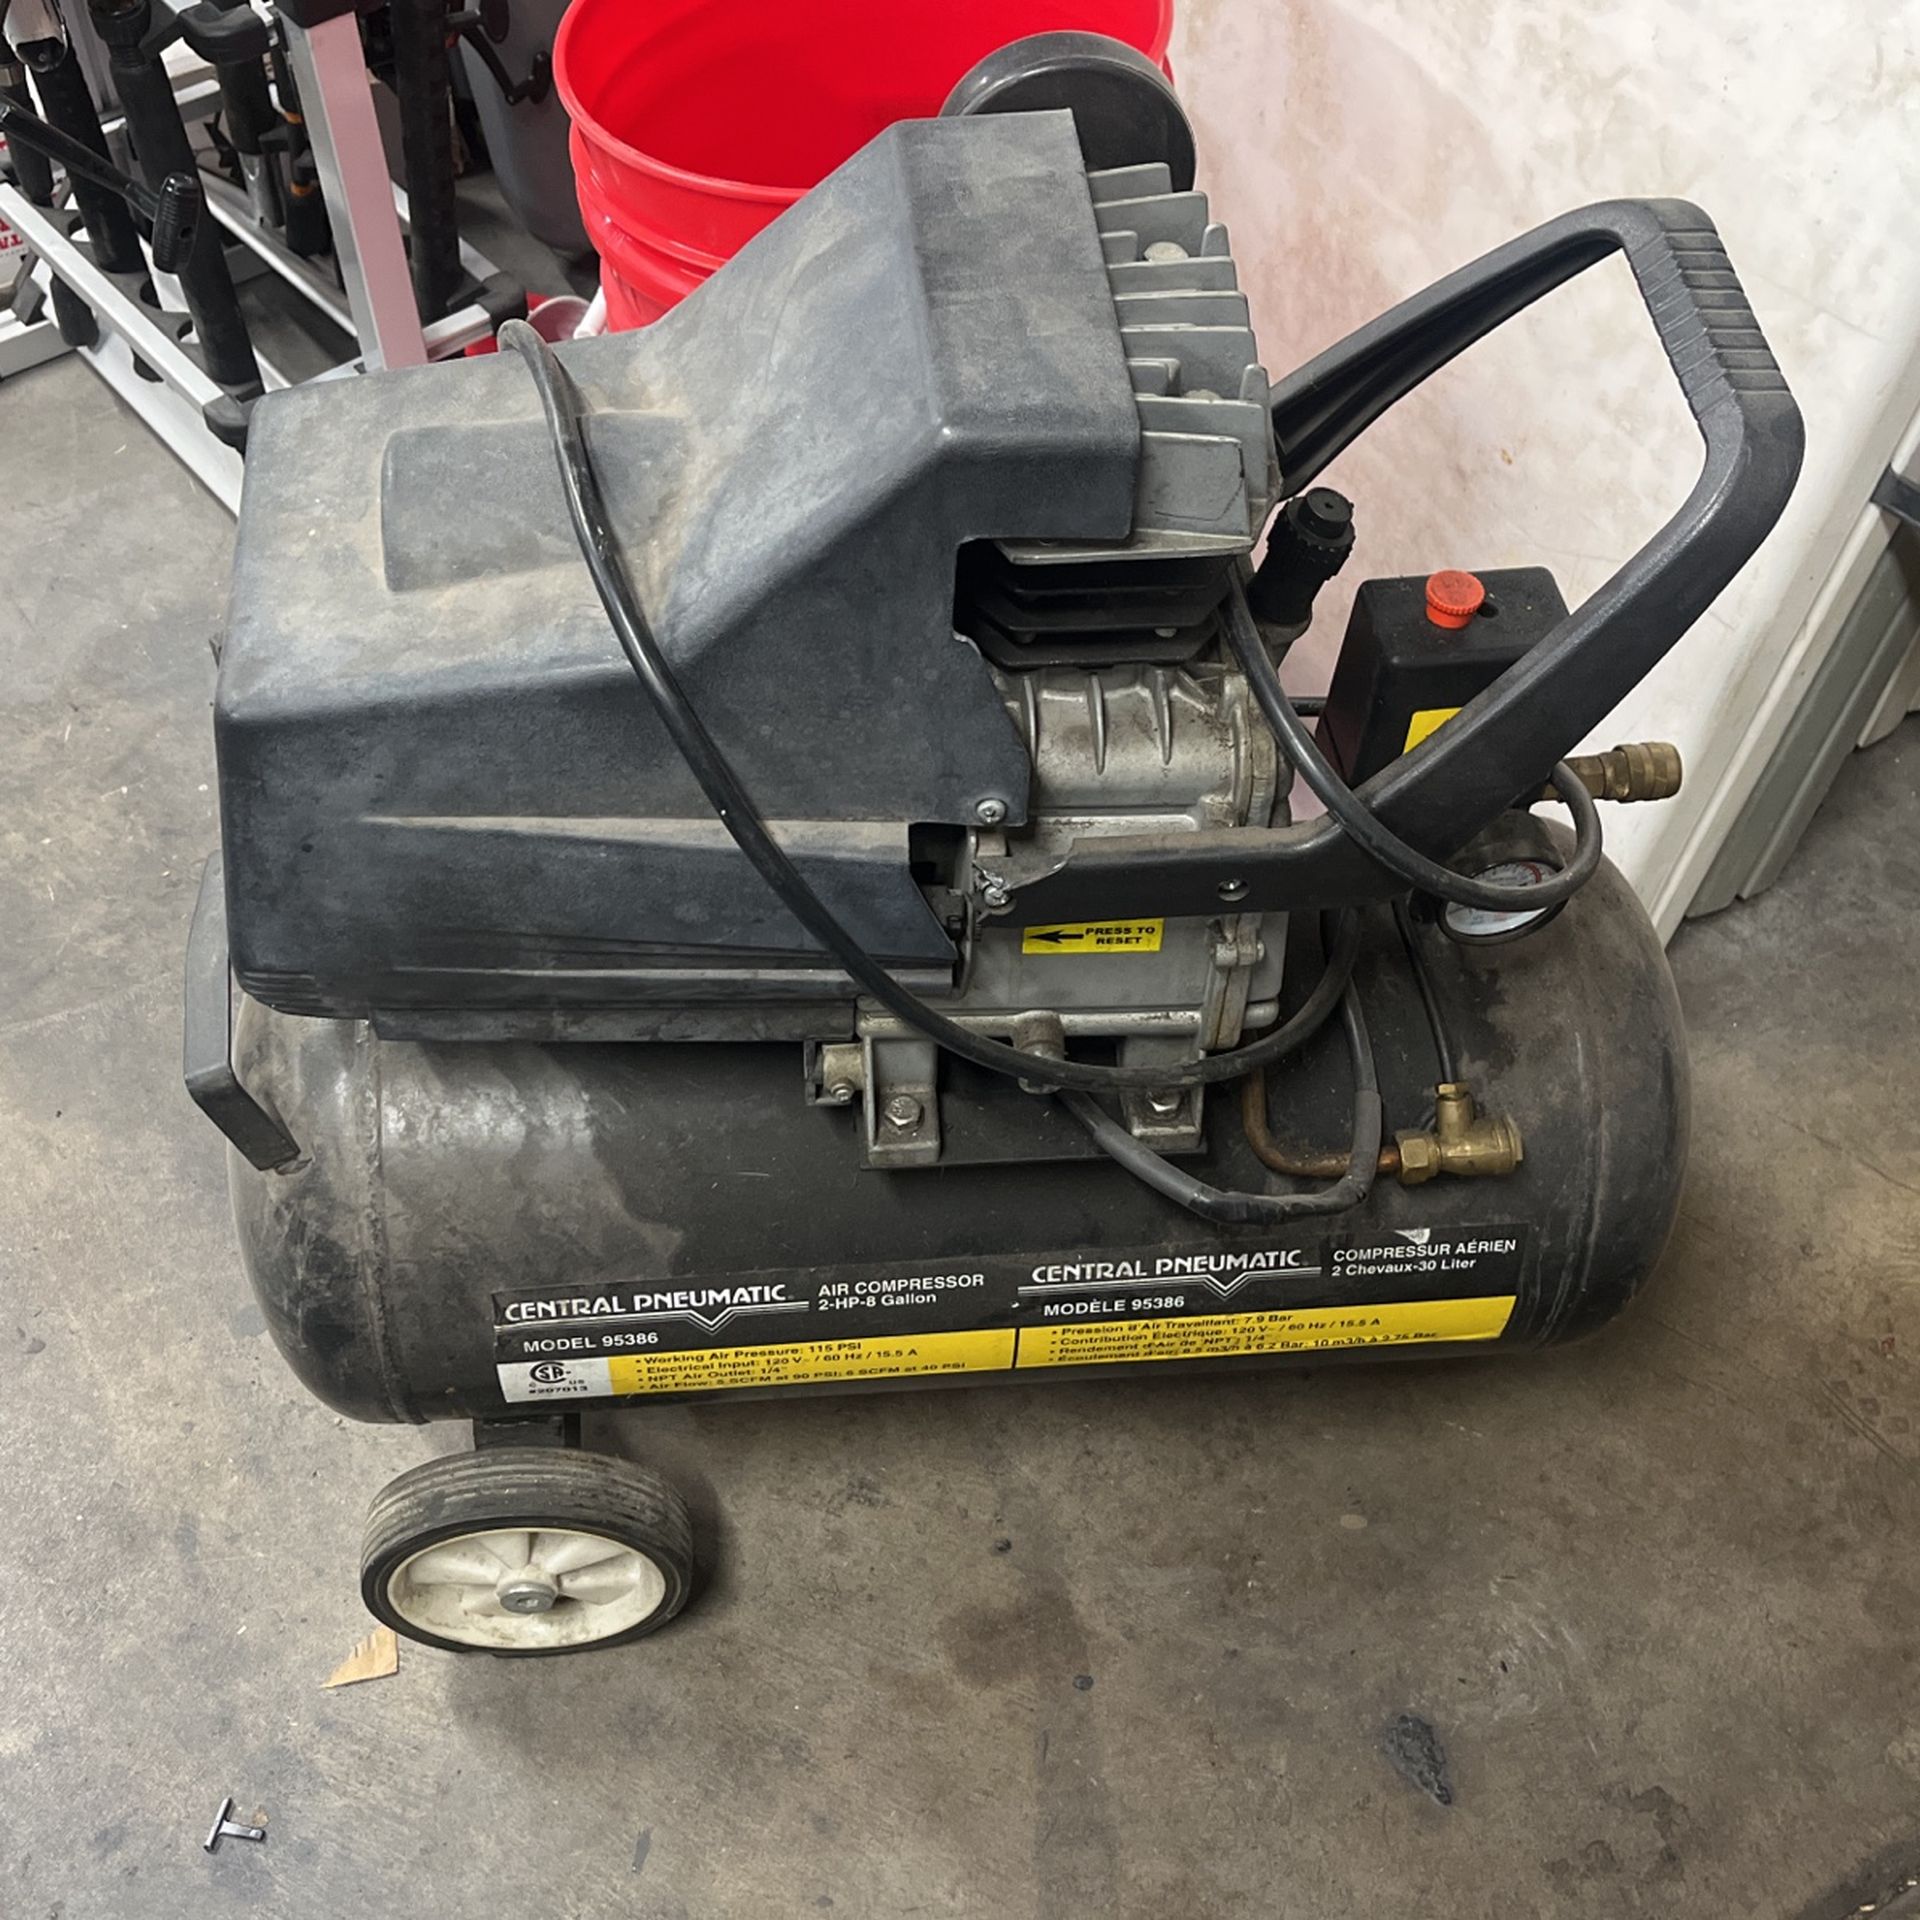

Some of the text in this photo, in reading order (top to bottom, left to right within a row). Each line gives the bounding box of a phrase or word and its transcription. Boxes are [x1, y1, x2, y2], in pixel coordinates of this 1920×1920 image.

[1085, 926, 1156, 935] PRESS TO
[1096, 936, 1142, 945] RESET
[1333, 1238, 1517, 1262] COMPRESSUR AÉRIEN
[1032, 1250, 1302, 1283] CENTRAL PNEUMATIC
[1331, 1258, 1477, 1276] 2 Chevaux-30 Liter
[818, 1274, 985, 1298] AIR COMPRESSOR
[505, 1284, 786, 1322] CENTRAL PNEUMATIC
[818, 1292, 937, 1311] 2-HP-8 Gallon
[1044, 1295, 1185, 1316] MODÈLE 95386
[1060, 1334, 1147, 1346] Contribution
[1232, 1326, 1255, 1334] 120
[1288, 1323, 1305, 1331] 60
[1308, 1321, 1326, 1329] Hz
[1370, 1317, 1380, 1326] A
[1062, 1325, 1123, 1335] Pression
[1268, 1314, 1293, 1322] Bar
[523, 1331, 658, 1353] MODEL 95386
[1059, 1342, 1138, 1354] Rendement
[1313, 1339, 1329, 1347] 10
[644, 1341, 862, 1365] Working Air Pressure: 115 PSI
[647, 1362, 714, 1374] Electrical
[719, 1360, 760, 1370] Input:
[766, 1357, 789, 1366] 120
[823, 1353, 840, 1362] 60
[845, 1351, 862, 1360] Hz
[876, 1349, 903, 1358] 15.5
[908, 1348, 918, 1356] A
[648, 1374, 677, 1382] NPT
[682, 1372, 703, 1380] Air
[708, 1369, 757, 1379] Outlet:
[793, 1372, 810, 1380] 90
[858, 1366, 900, 1375] SCFM
[942, 1362, 966, 1370] PSI
